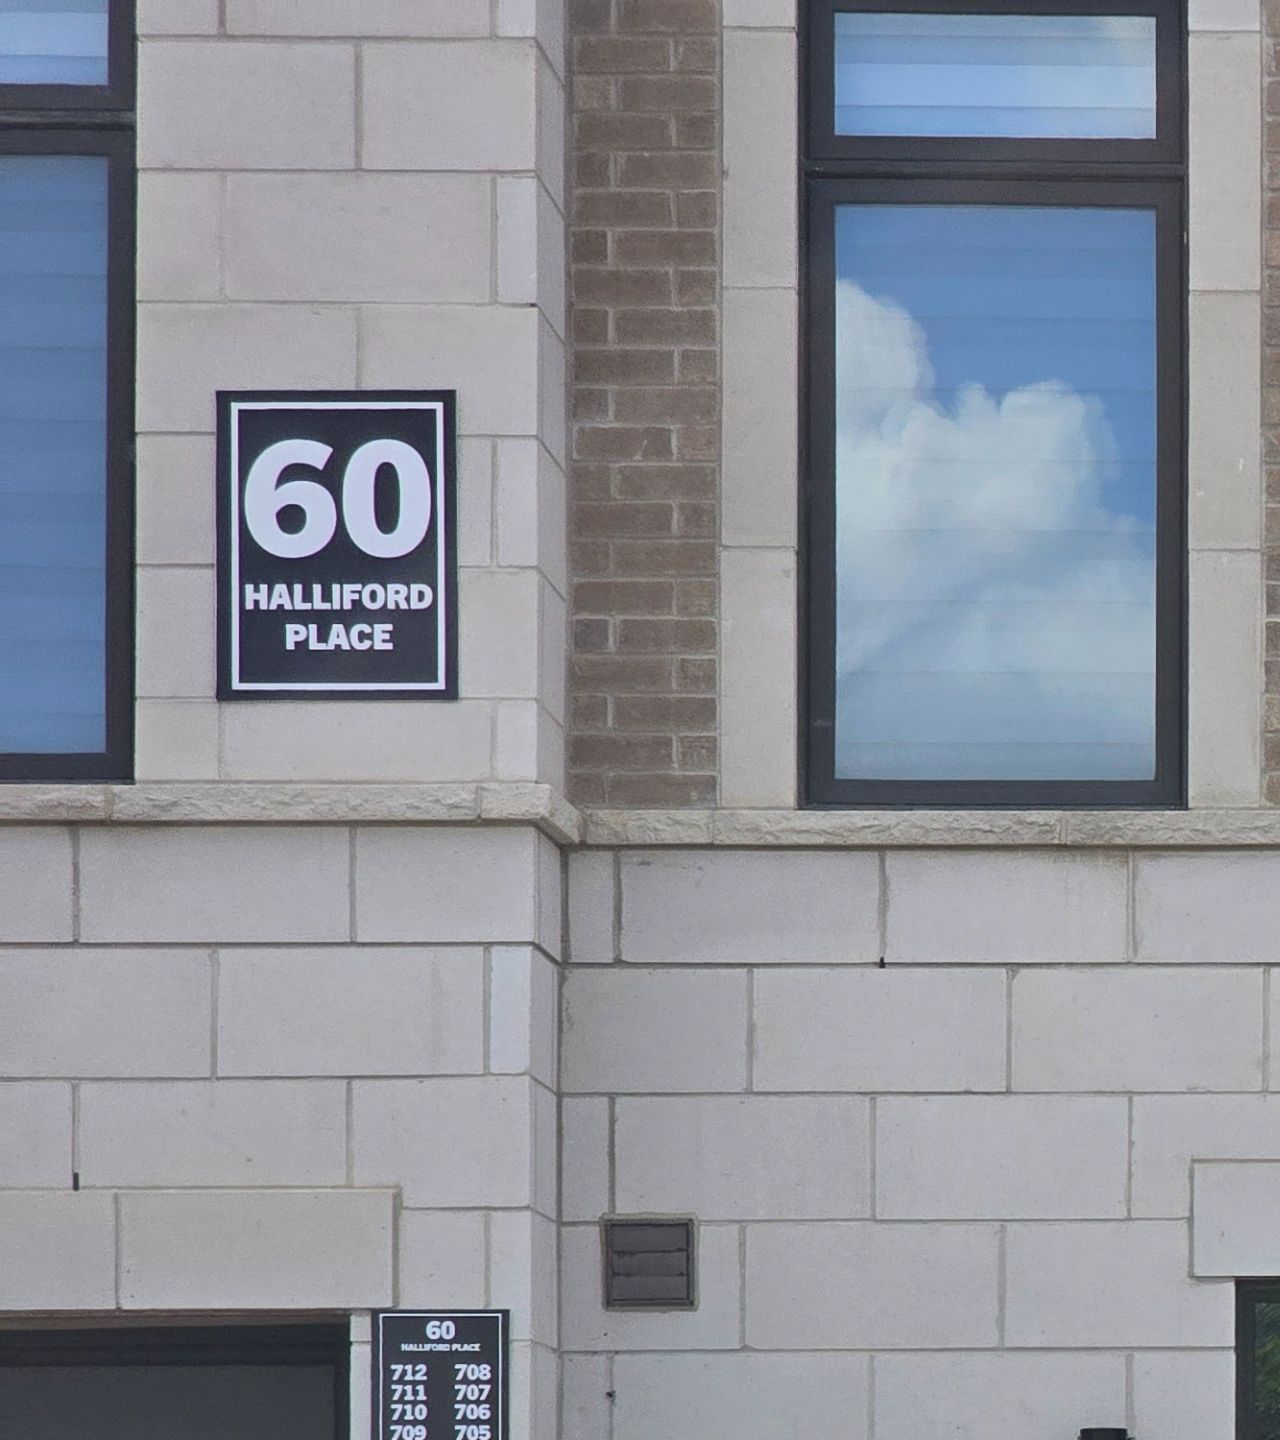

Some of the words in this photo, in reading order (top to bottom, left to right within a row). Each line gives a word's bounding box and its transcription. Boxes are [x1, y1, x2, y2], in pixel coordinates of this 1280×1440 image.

[244, 438, 432, 559] 60
[244, 583, 433, 611] HALLIFORD
[285, 623, 394, 651] PLACE
[426, 1320, 456, 1340] 60
[401, 1343, 451, 1352] HALLIFORD
[451, 1343, 481, 1352] PLACE
[390, 1364, 428, 1381] 712
[454, 1364, 491, 1381] 708
[390, 1384, 428, 1401] 711
[454, 1384, 491, 1401] 707
[390, 1404, 428, 1421] 710
[454, 1404, 491, 1421] 706
